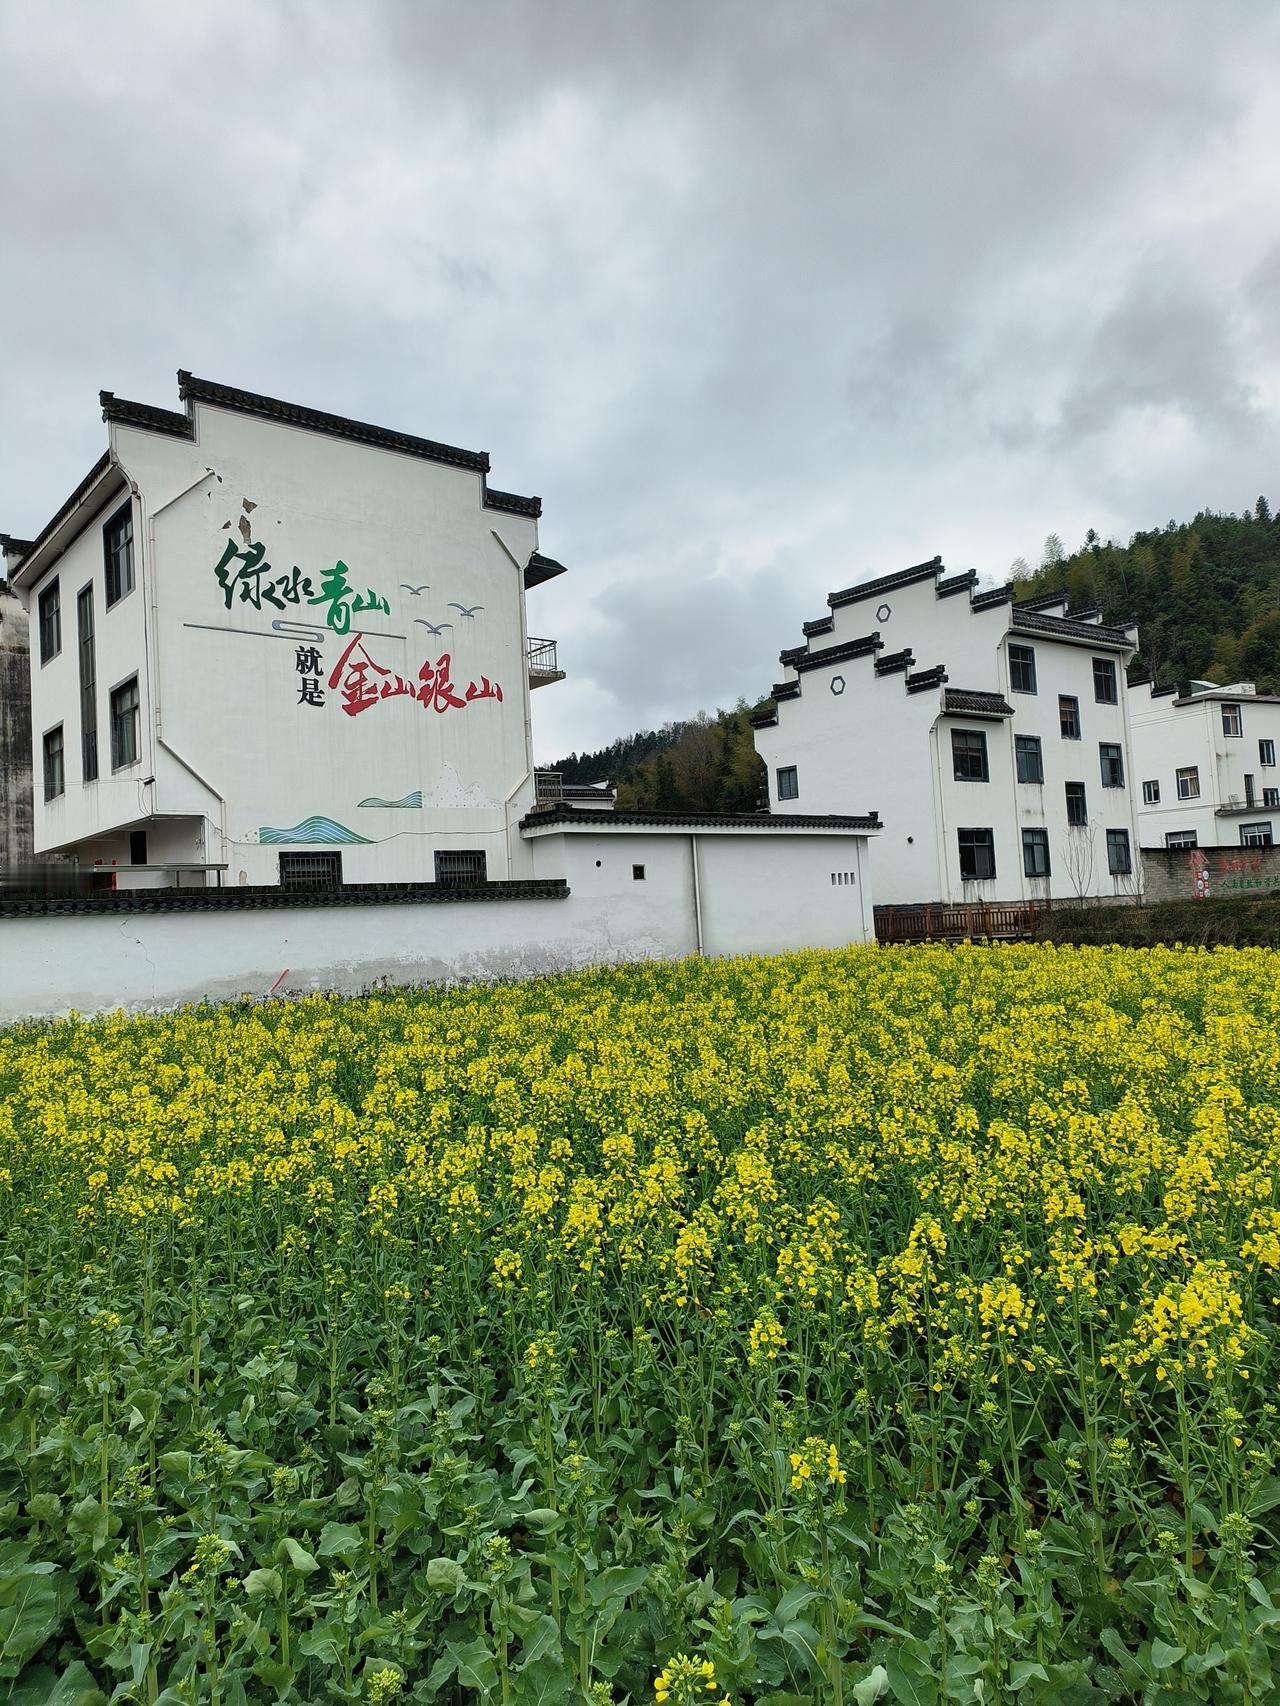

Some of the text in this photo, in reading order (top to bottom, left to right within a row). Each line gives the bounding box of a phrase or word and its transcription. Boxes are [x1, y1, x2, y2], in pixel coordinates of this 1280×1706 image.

[214, 538, 391, 635] 绿水青山
[295, 645, 326, 708] 就是
[328, 633, 503, 717] 金山银山
